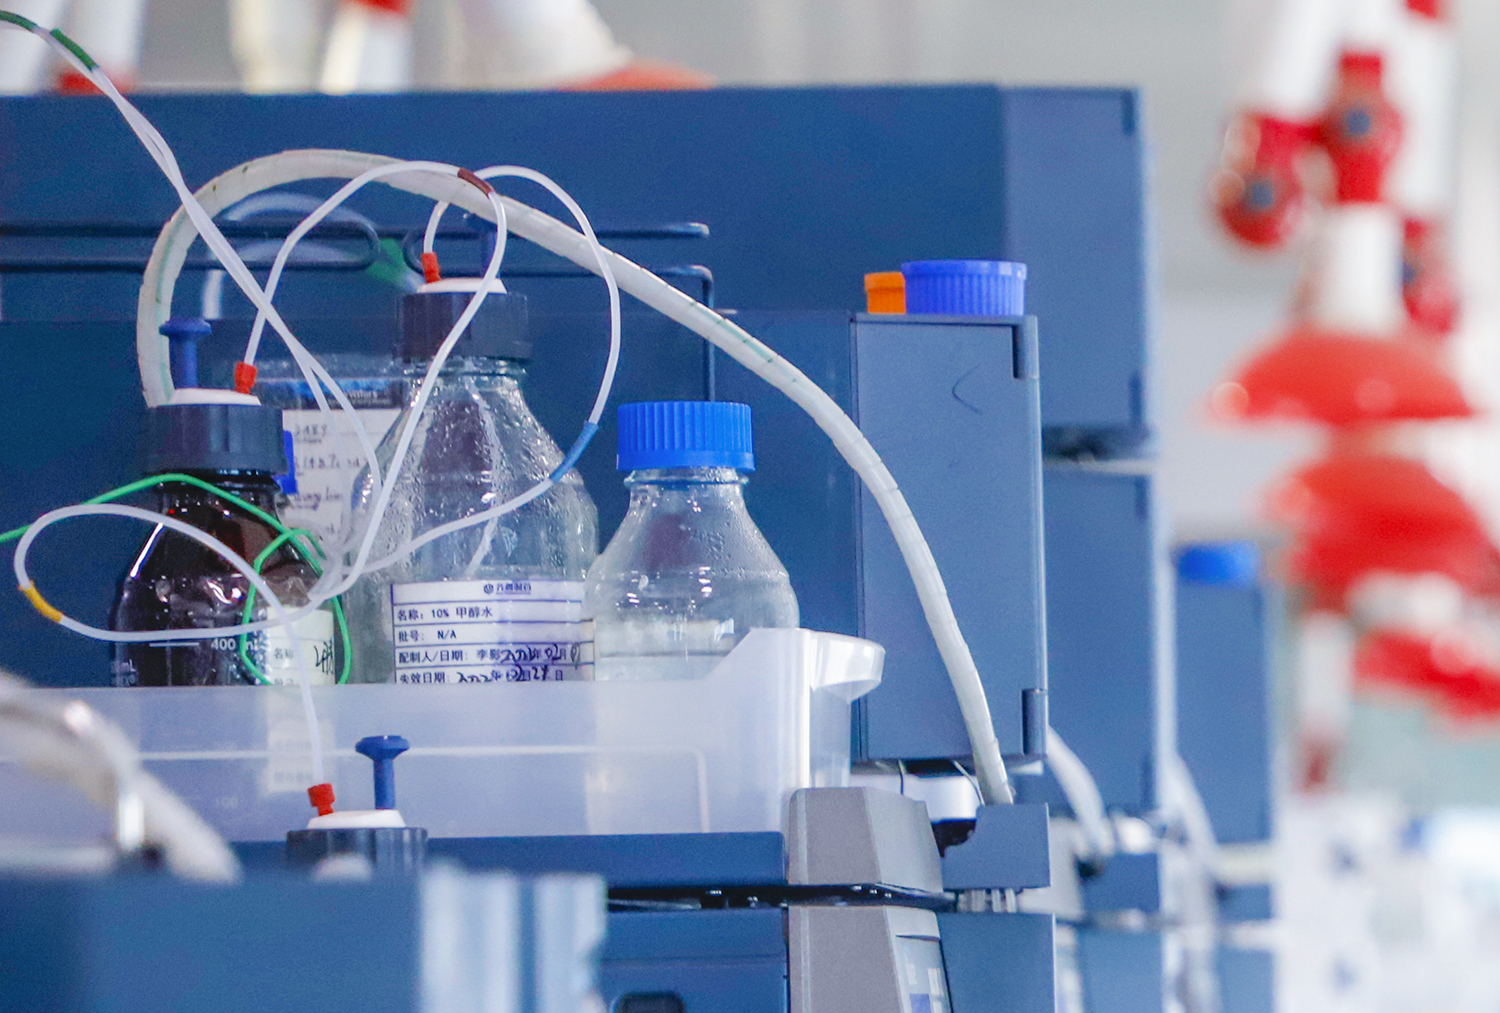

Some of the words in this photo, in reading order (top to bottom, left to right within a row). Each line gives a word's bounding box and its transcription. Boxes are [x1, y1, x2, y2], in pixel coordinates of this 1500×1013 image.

[431, 608, 450, 619] 10%
[455, 605, 494, 619] 甲醇水
[437, 629, 457, 640] N/A
[211, 638, 236, 651] 400
